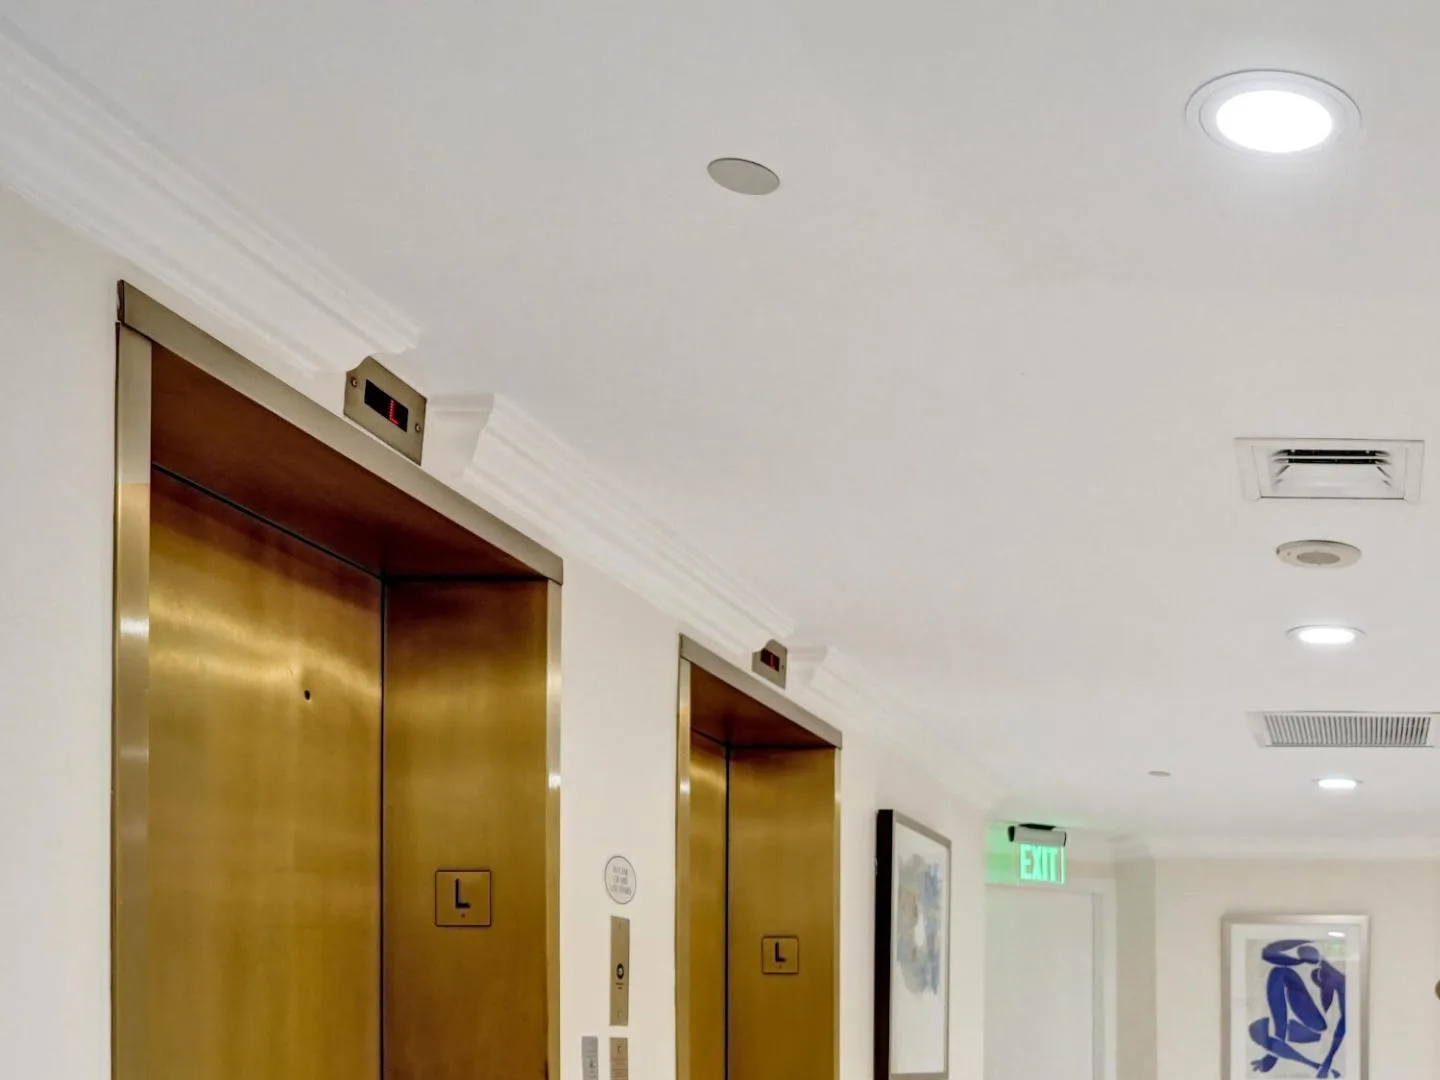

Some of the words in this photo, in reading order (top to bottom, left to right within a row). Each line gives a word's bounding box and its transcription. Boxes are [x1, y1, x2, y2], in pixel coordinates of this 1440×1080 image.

[388, 399, 399, 425] L
[1019, 843, 1058, 882] EXIT
[455, 878, 471, 909] L
[775, 941, 786, 962] L
